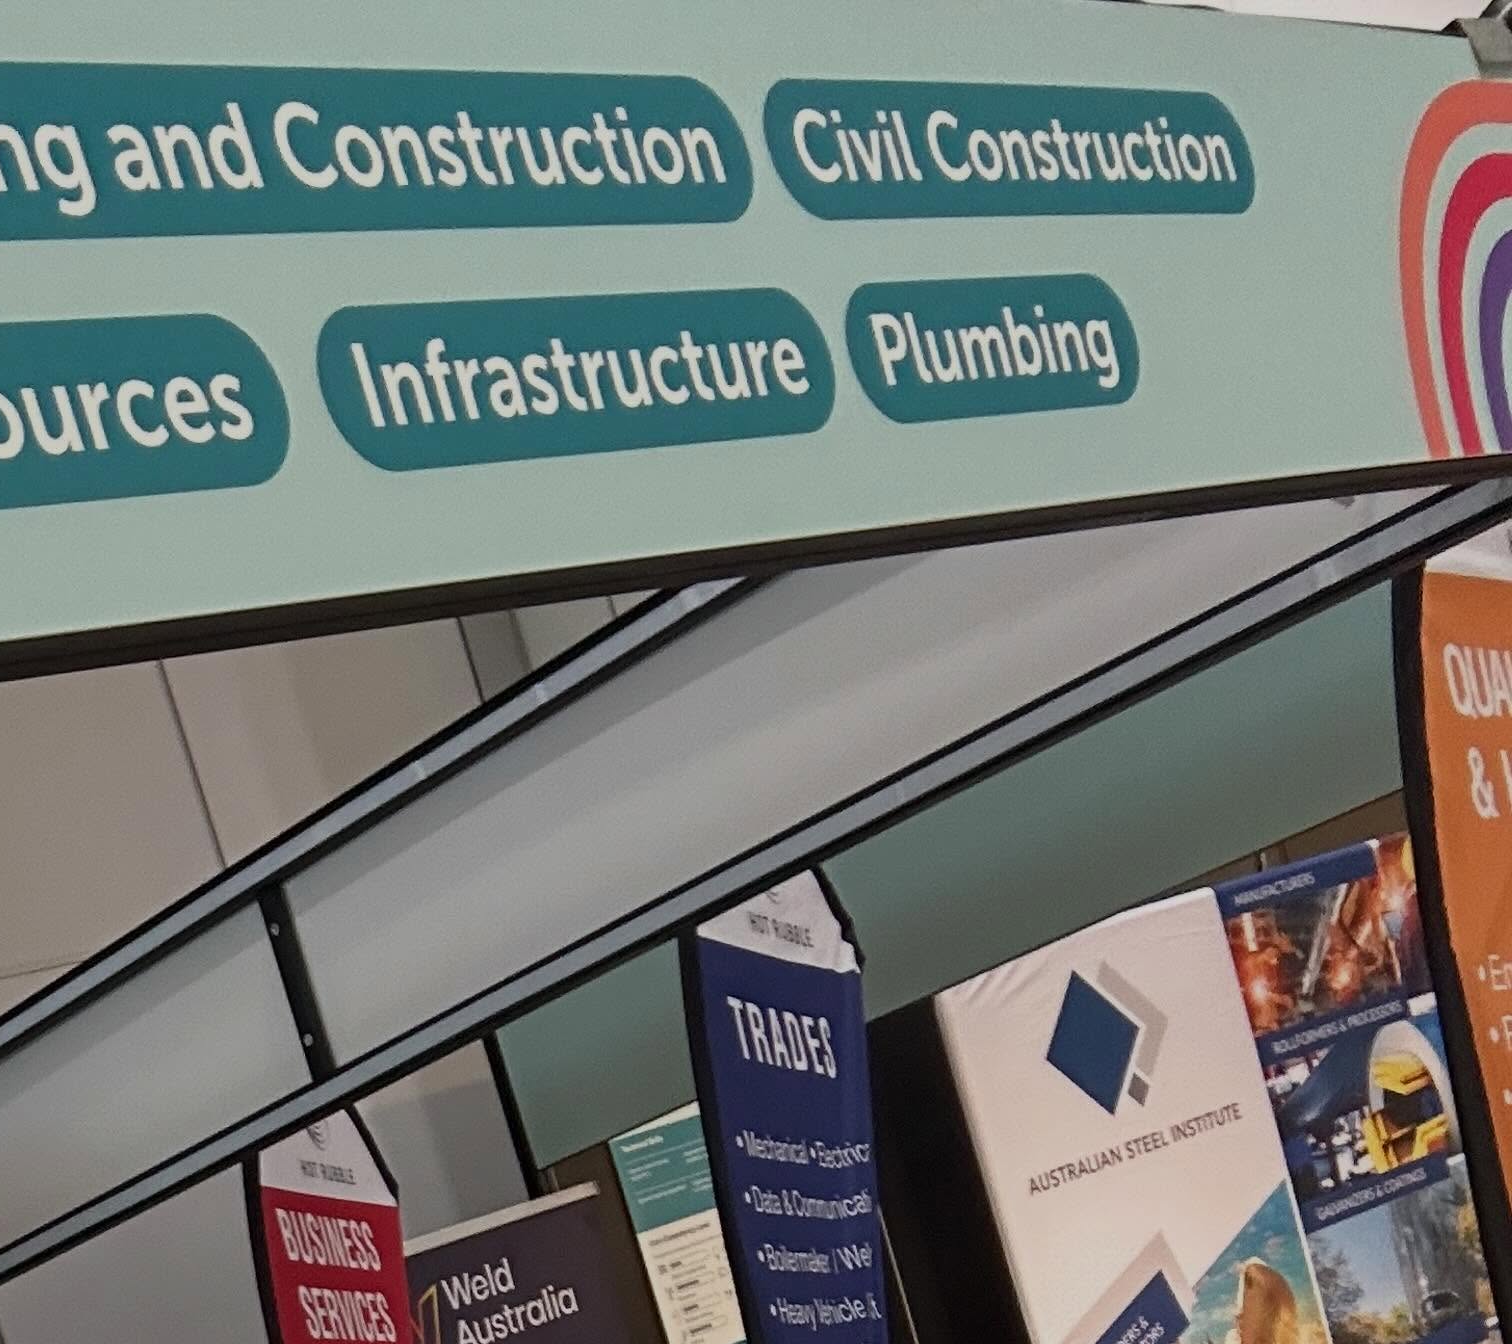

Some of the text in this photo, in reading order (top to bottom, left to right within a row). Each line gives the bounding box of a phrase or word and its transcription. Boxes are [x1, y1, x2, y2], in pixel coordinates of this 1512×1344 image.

[112, 102, 264, 190] and
[273, 101, 727, 189] Construction
[792, 107, 1238, 184] Civil Construction
[350, 329, 811, 429] Infrastructure
[866, 304, 1121, 389] Plumbing
[726, 995, 837, 1079] TRADES
[1028, 1102, 1243, 1196] AUSTRALIAN STEEL INSTITUTE
[274, 1207, 382, 1273] BUSINESS
[297, 1284, 398, 1343] SERVICES
[440, 1256, 516, 1311] Weld
